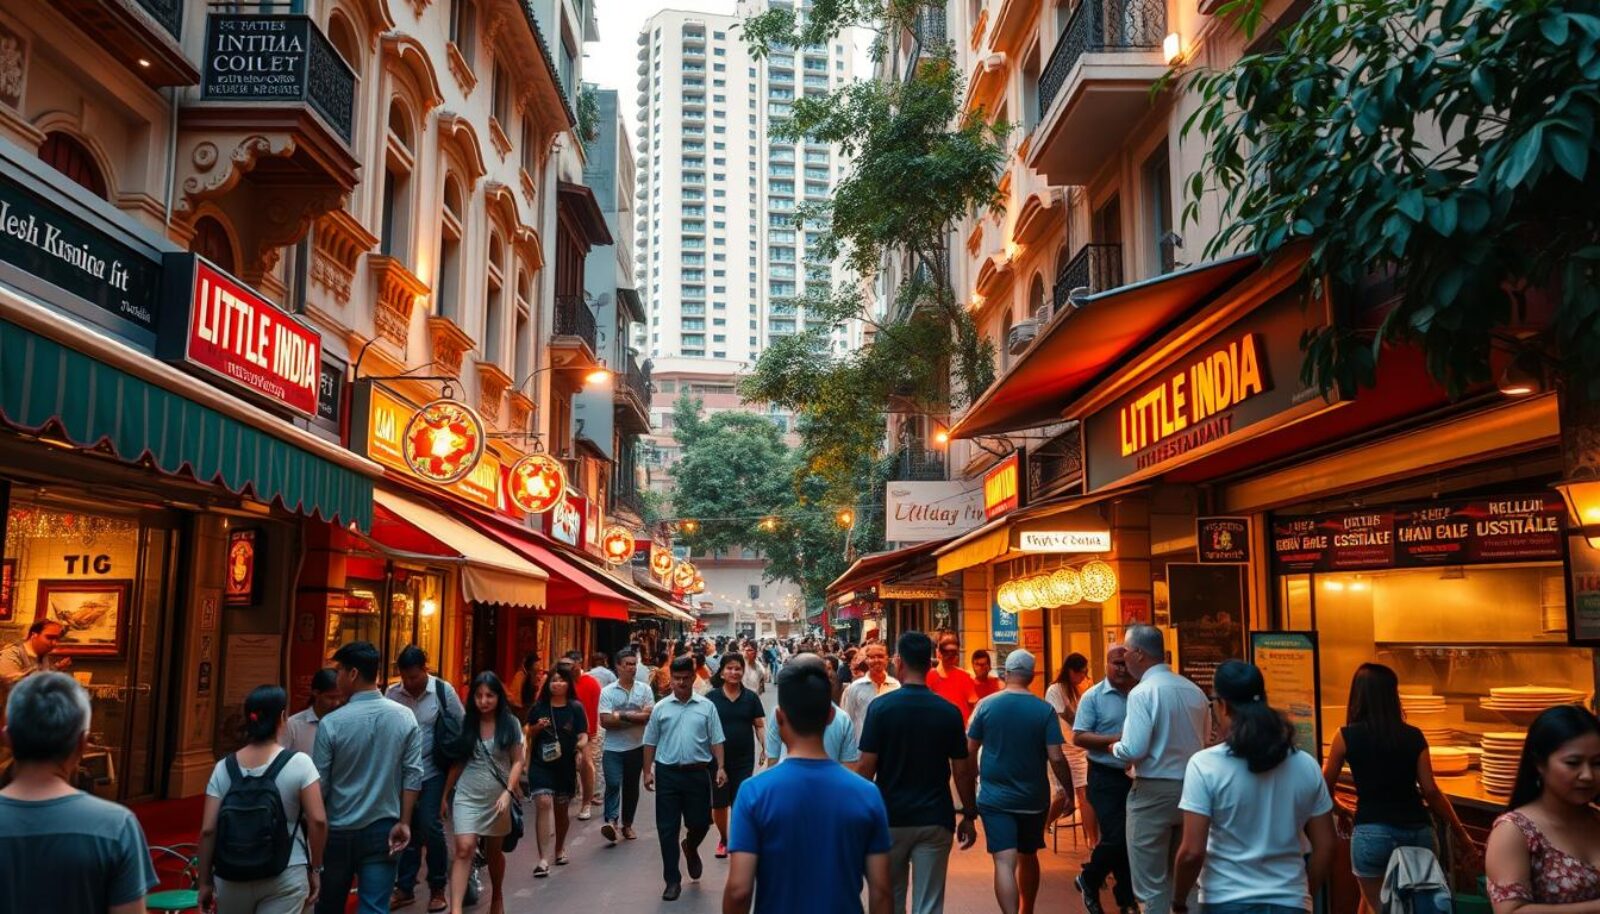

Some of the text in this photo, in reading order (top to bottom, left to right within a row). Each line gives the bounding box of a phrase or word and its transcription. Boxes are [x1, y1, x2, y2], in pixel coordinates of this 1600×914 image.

[198, 278, 271, 369] LITTLE
[273, 323, 316, 398] INDIA
[1120, 372, 1187, 458] LITTLE
[1190, 333, 1263, 423] INDIA
[64, 554, 112, 574] TIG
